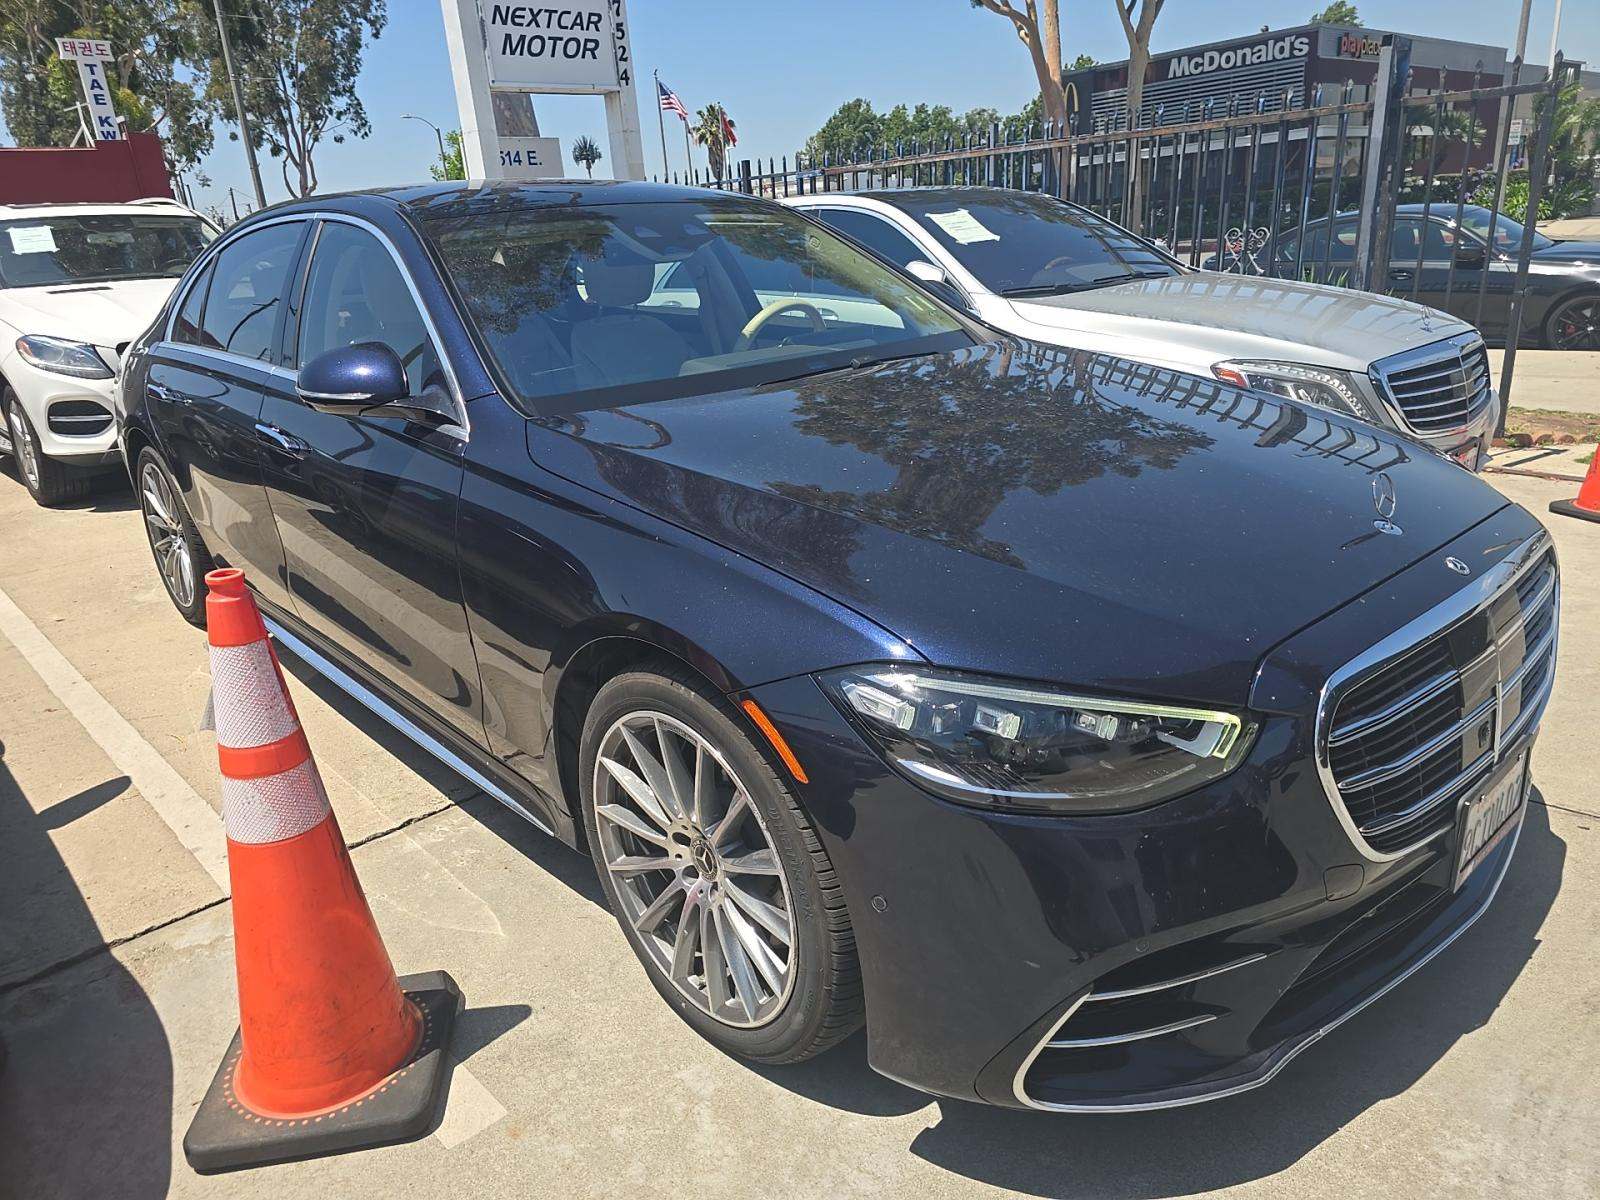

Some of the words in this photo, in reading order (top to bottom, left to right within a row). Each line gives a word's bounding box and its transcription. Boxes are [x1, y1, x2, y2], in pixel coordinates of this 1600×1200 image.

[492, 5, 602, 32] NEXTCAR
[62, 41, 110, 56] 태권도
[502, 33, 600, 60] MOTOR
[1168, 36, 1309, 79] McDonald's
[1341, 32, 1381, 58] playplac
[84, 63, 107, 106] TAE
[527, 151, 543, 166] E.
